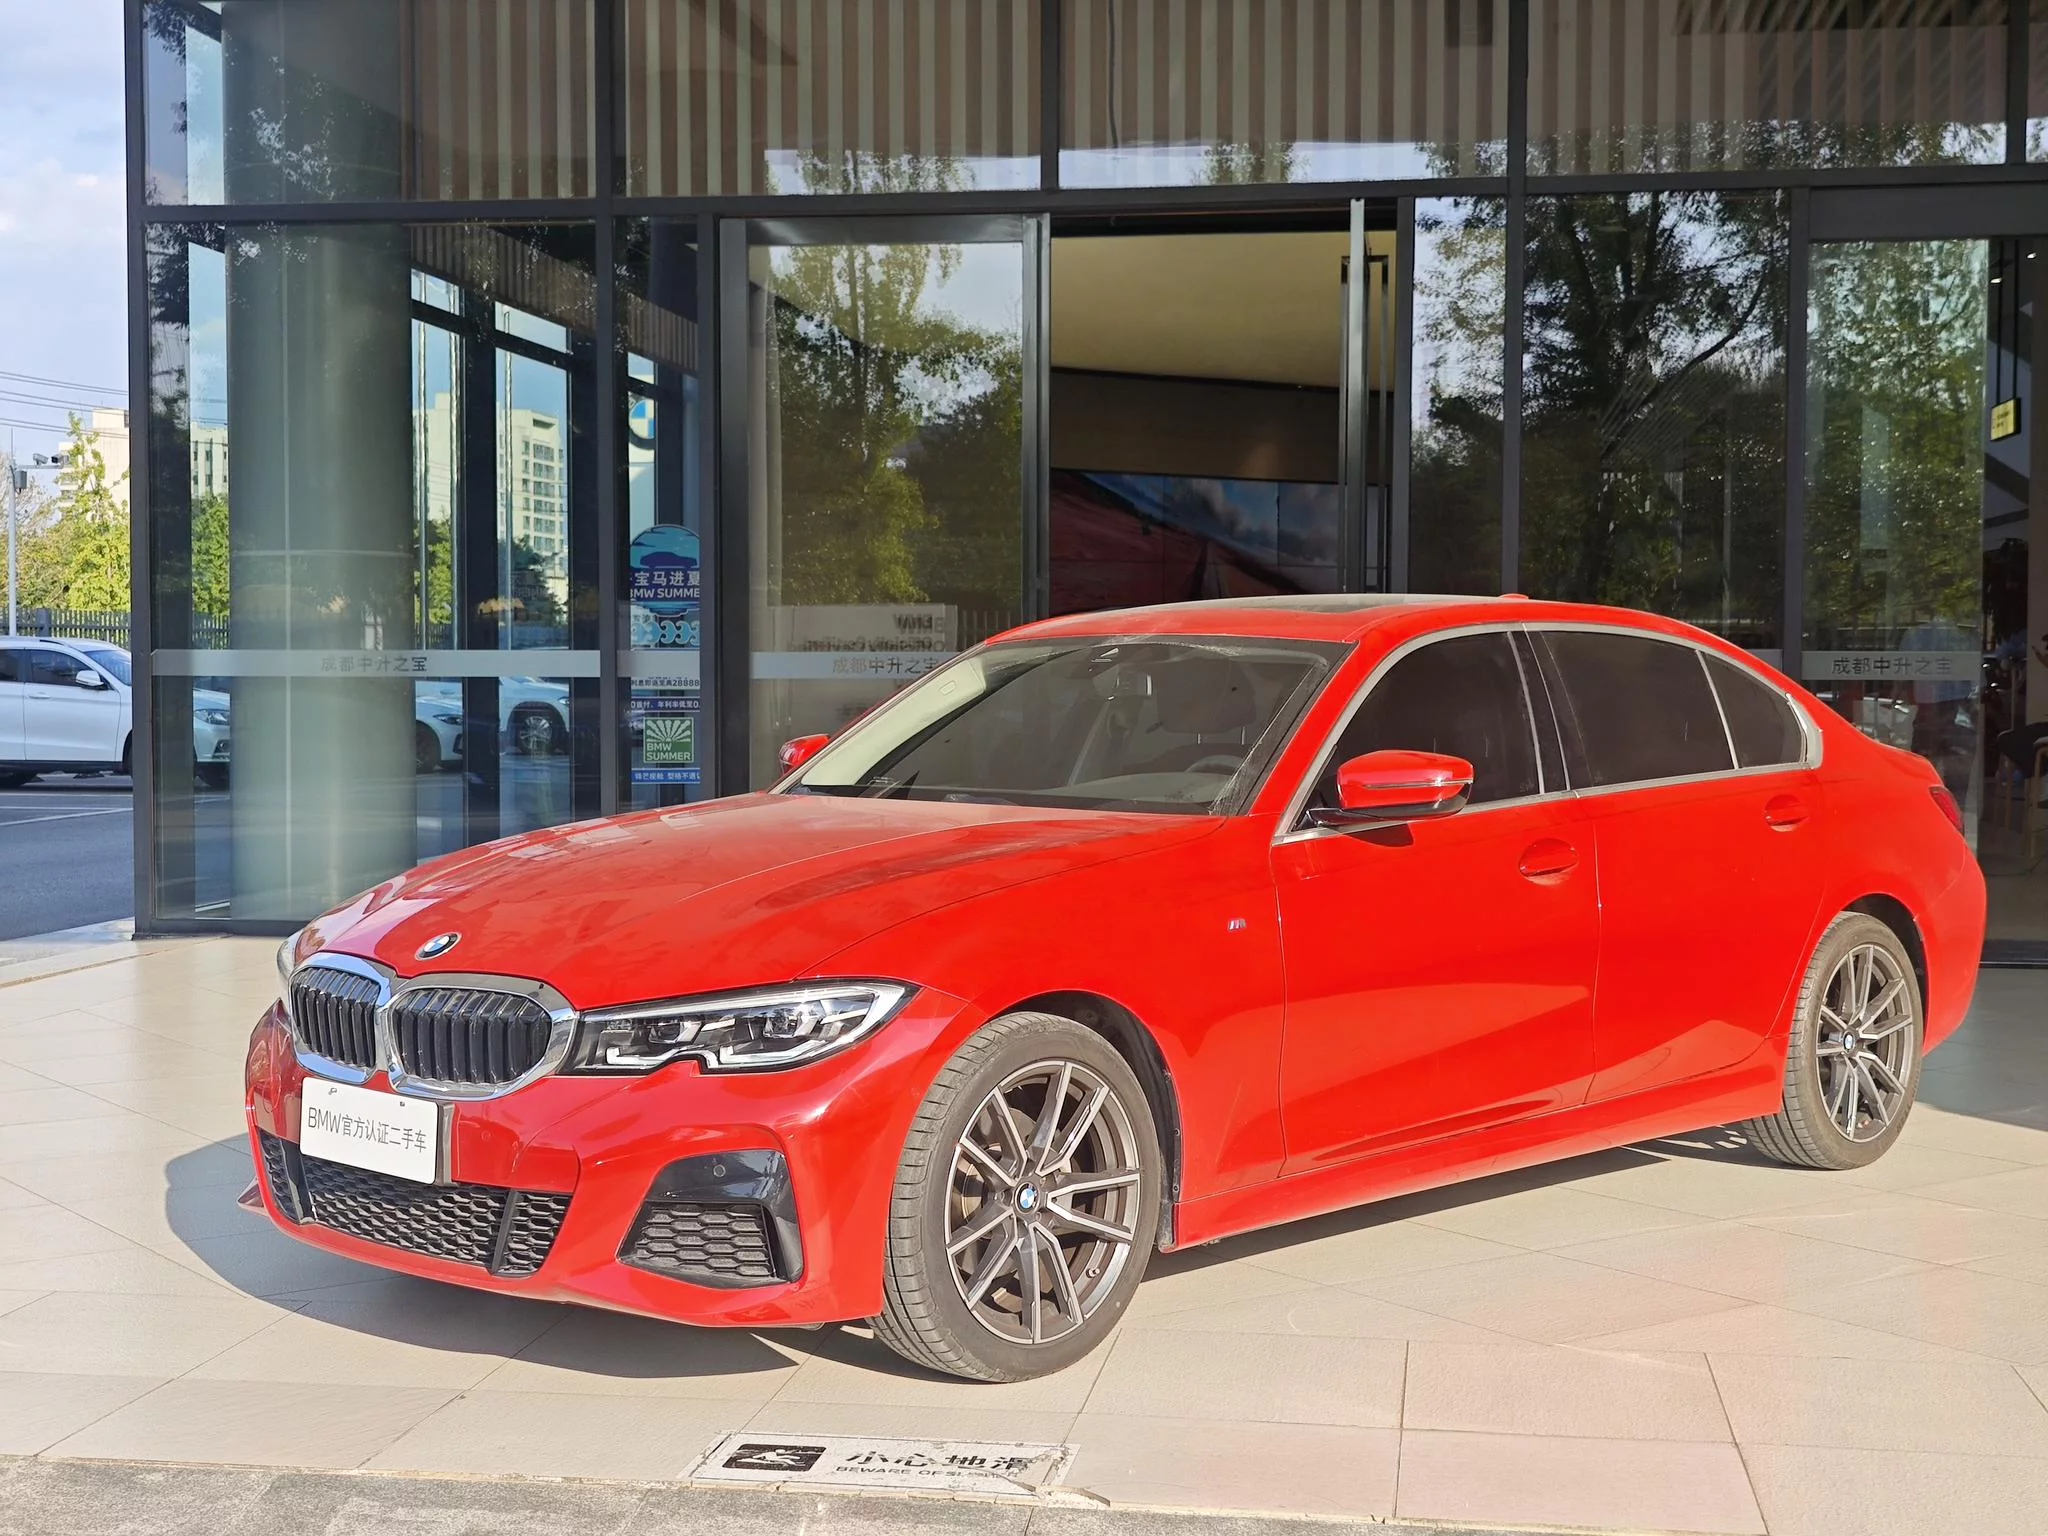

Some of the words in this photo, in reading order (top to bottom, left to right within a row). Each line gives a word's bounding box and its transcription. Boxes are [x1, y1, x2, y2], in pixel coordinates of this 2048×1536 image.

[630, 571, 700, 586] 宝马进夏
[321, 656, 428, 672] 成都中升之宝
[1831, 657, 1953, 675] 成都中升之宝
[647, 743, 672, 751] BMW
[646, 752, 691, 761] SUMMER
[308, 1106, 427, 1153] BMW官方认证二手车
[836, 1466, 911, 1475] BEWARE
